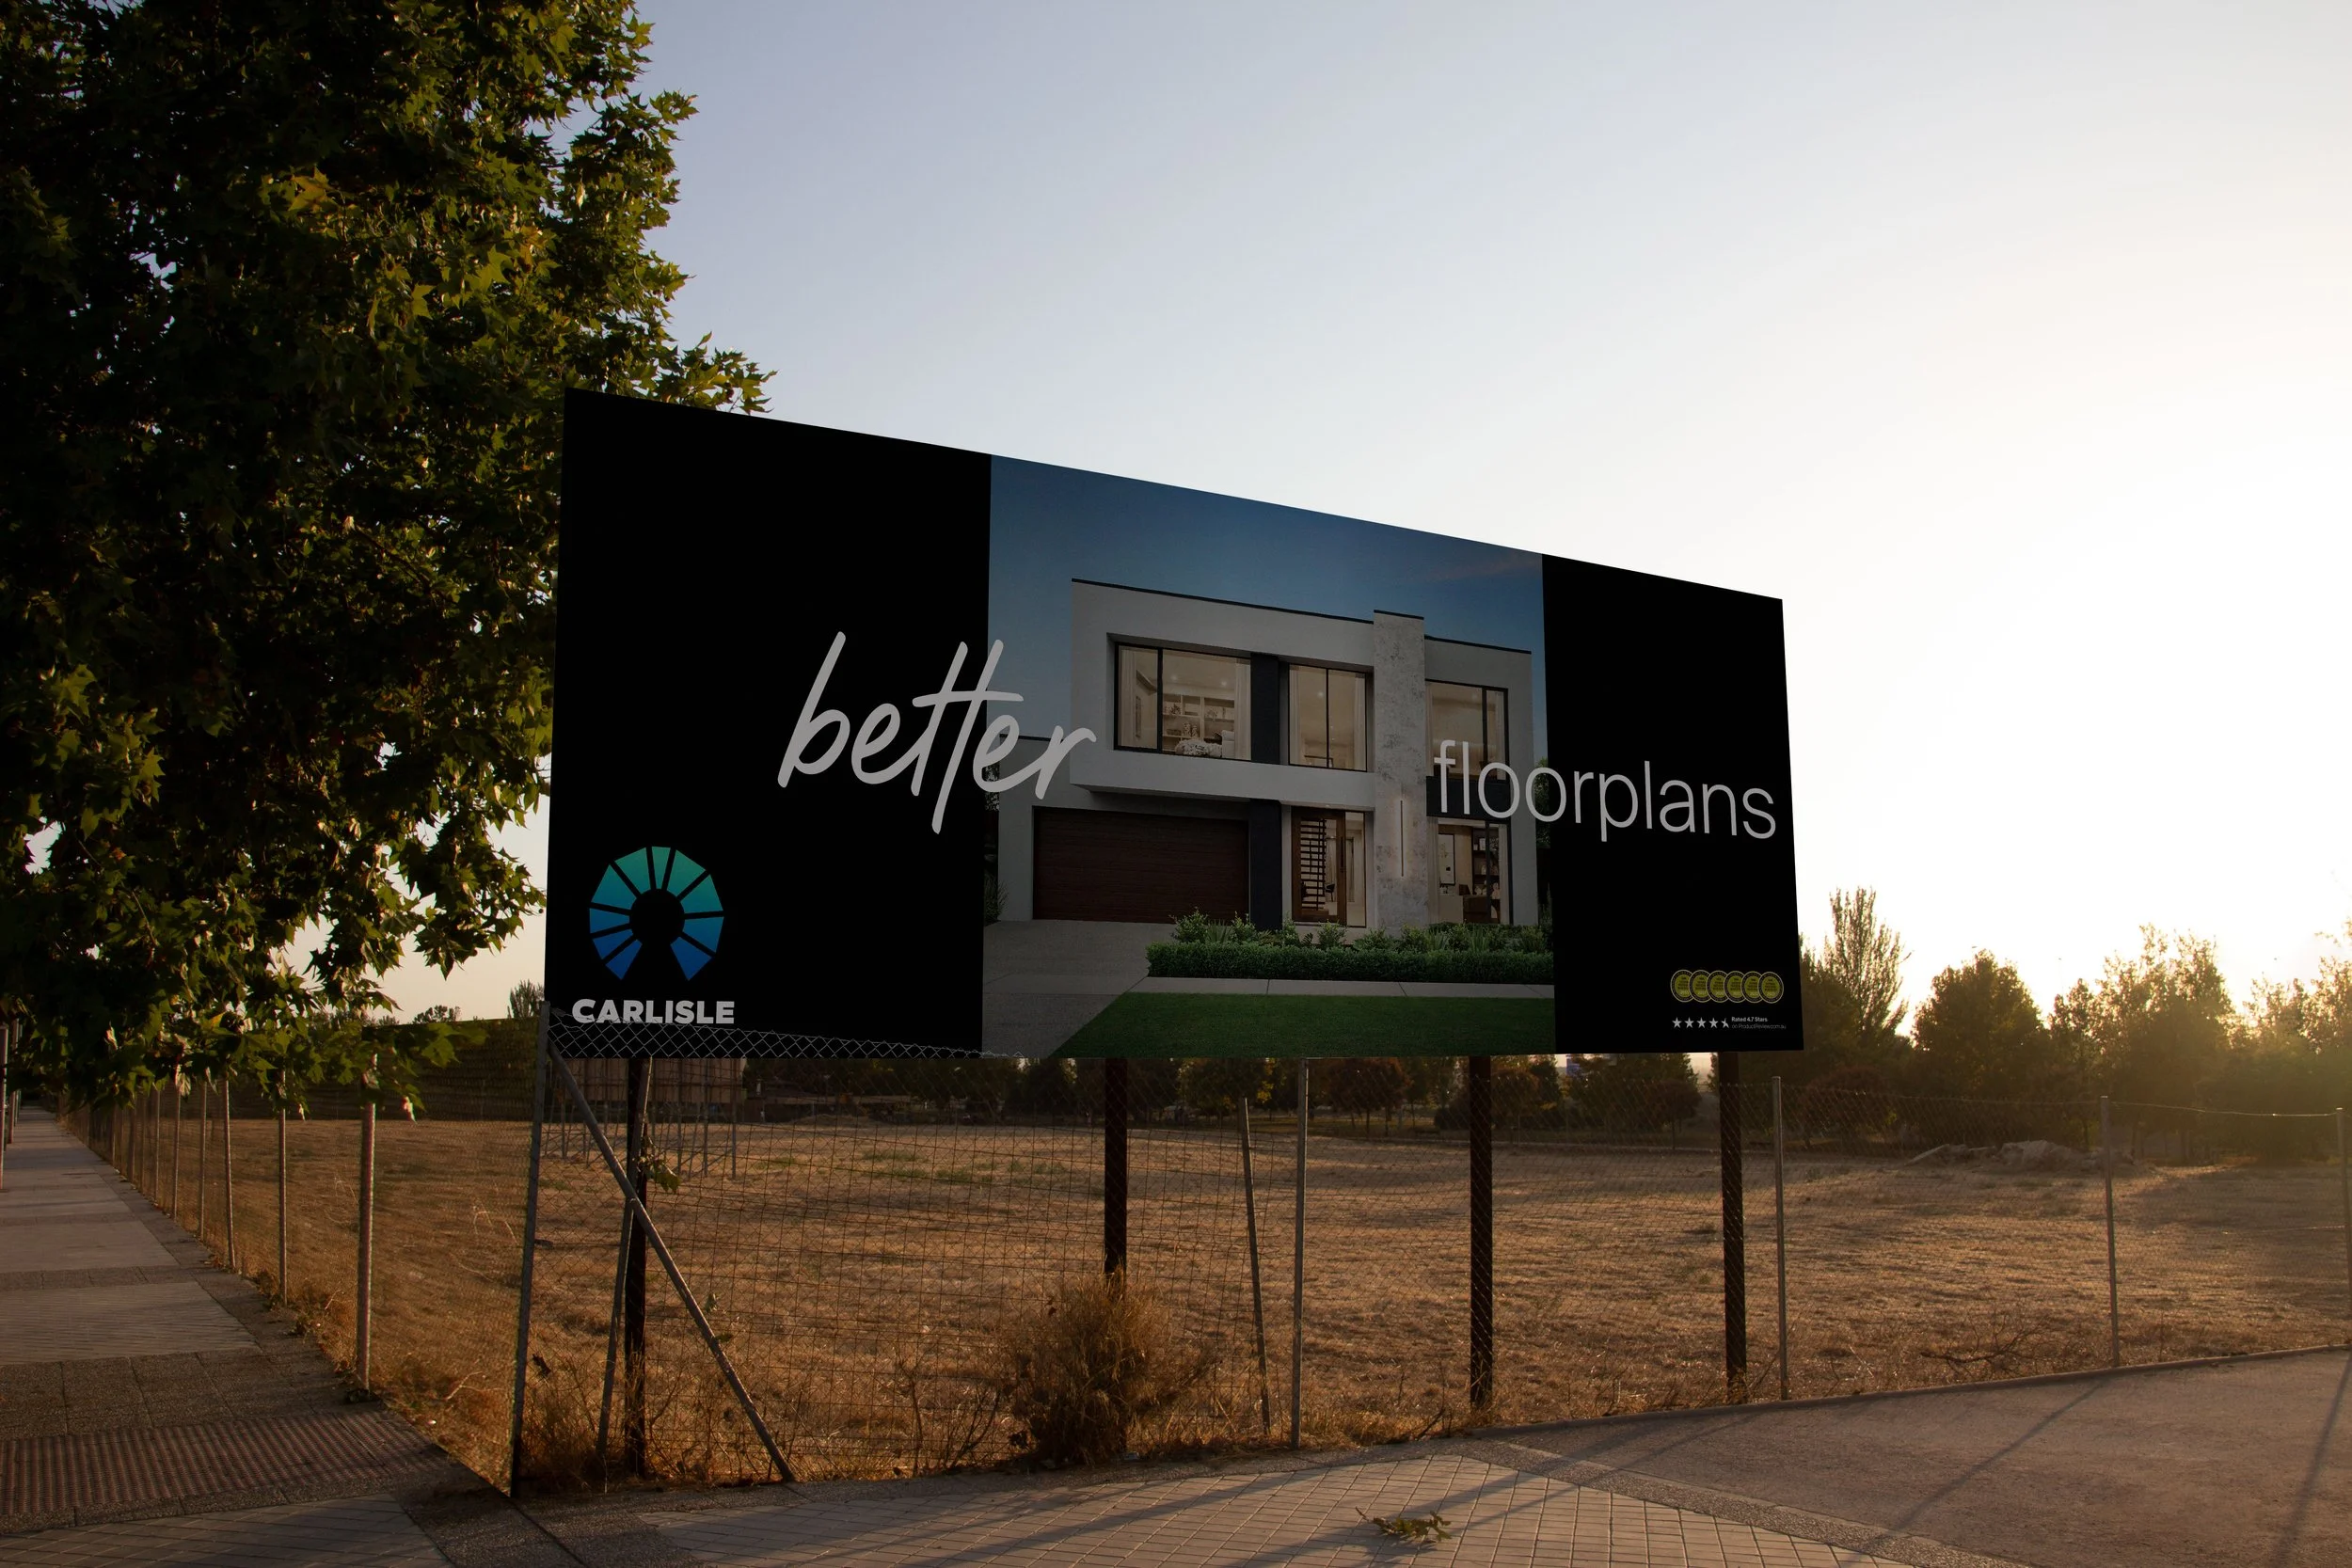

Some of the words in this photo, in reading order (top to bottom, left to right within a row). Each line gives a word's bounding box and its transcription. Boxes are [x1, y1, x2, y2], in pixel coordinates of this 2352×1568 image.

[777, 631, 1097, 834] better
[1434, 739, 1777, 842] floorplans
[572, 998, 736, 1024] CARLISLE
